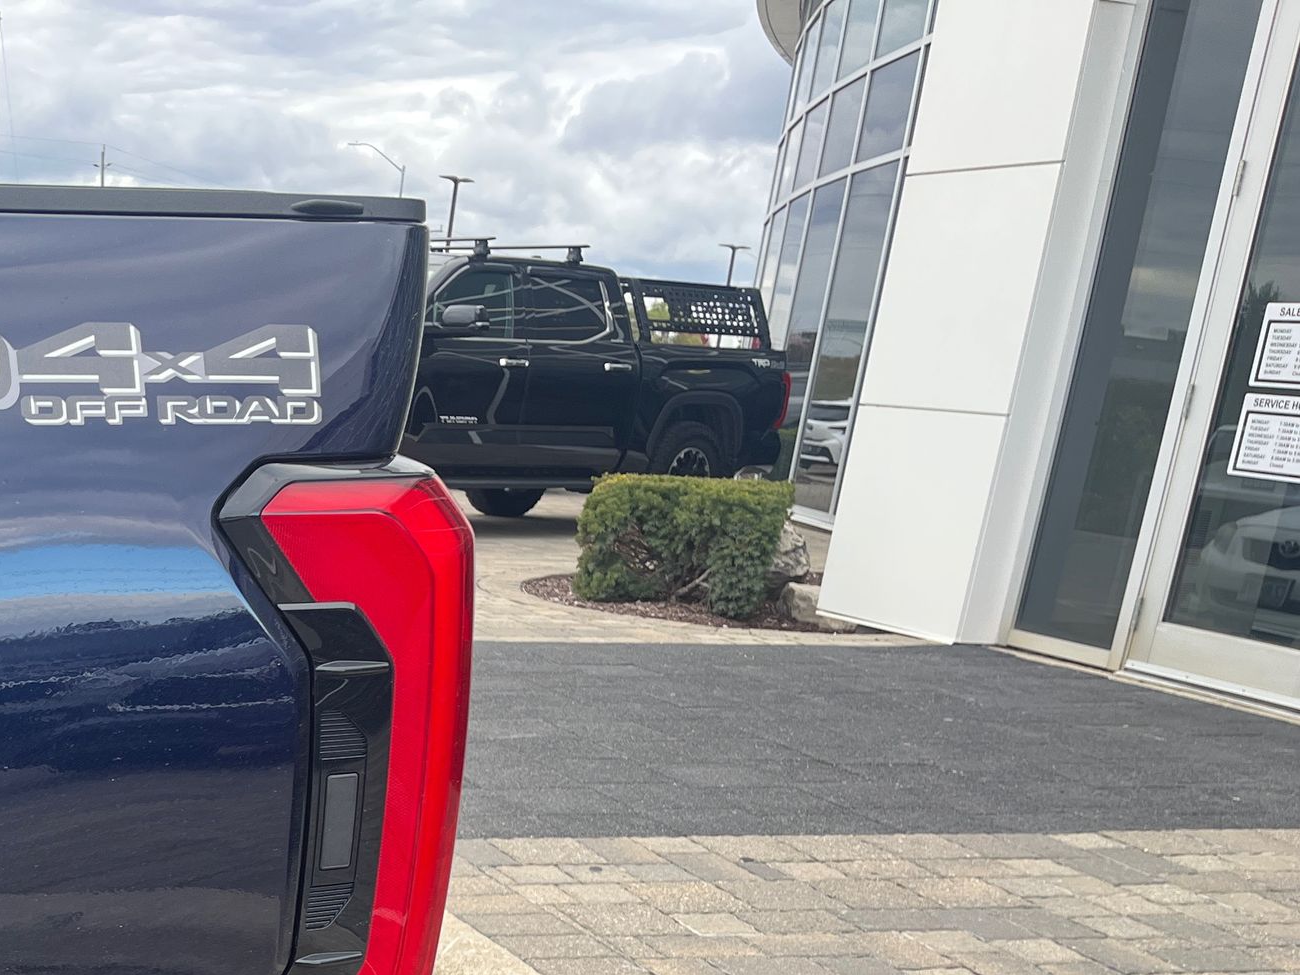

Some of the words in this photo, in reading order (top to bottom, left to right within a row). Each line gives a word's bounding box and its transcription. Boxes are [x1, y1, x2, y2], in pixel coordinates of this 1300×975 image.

[15, 321, 322, 398] 4x4
[21, 394, 148, 427] OFF
[157, 394, 322, 427] ROAD
[1253, 398, 1290, 410] SERVICE
